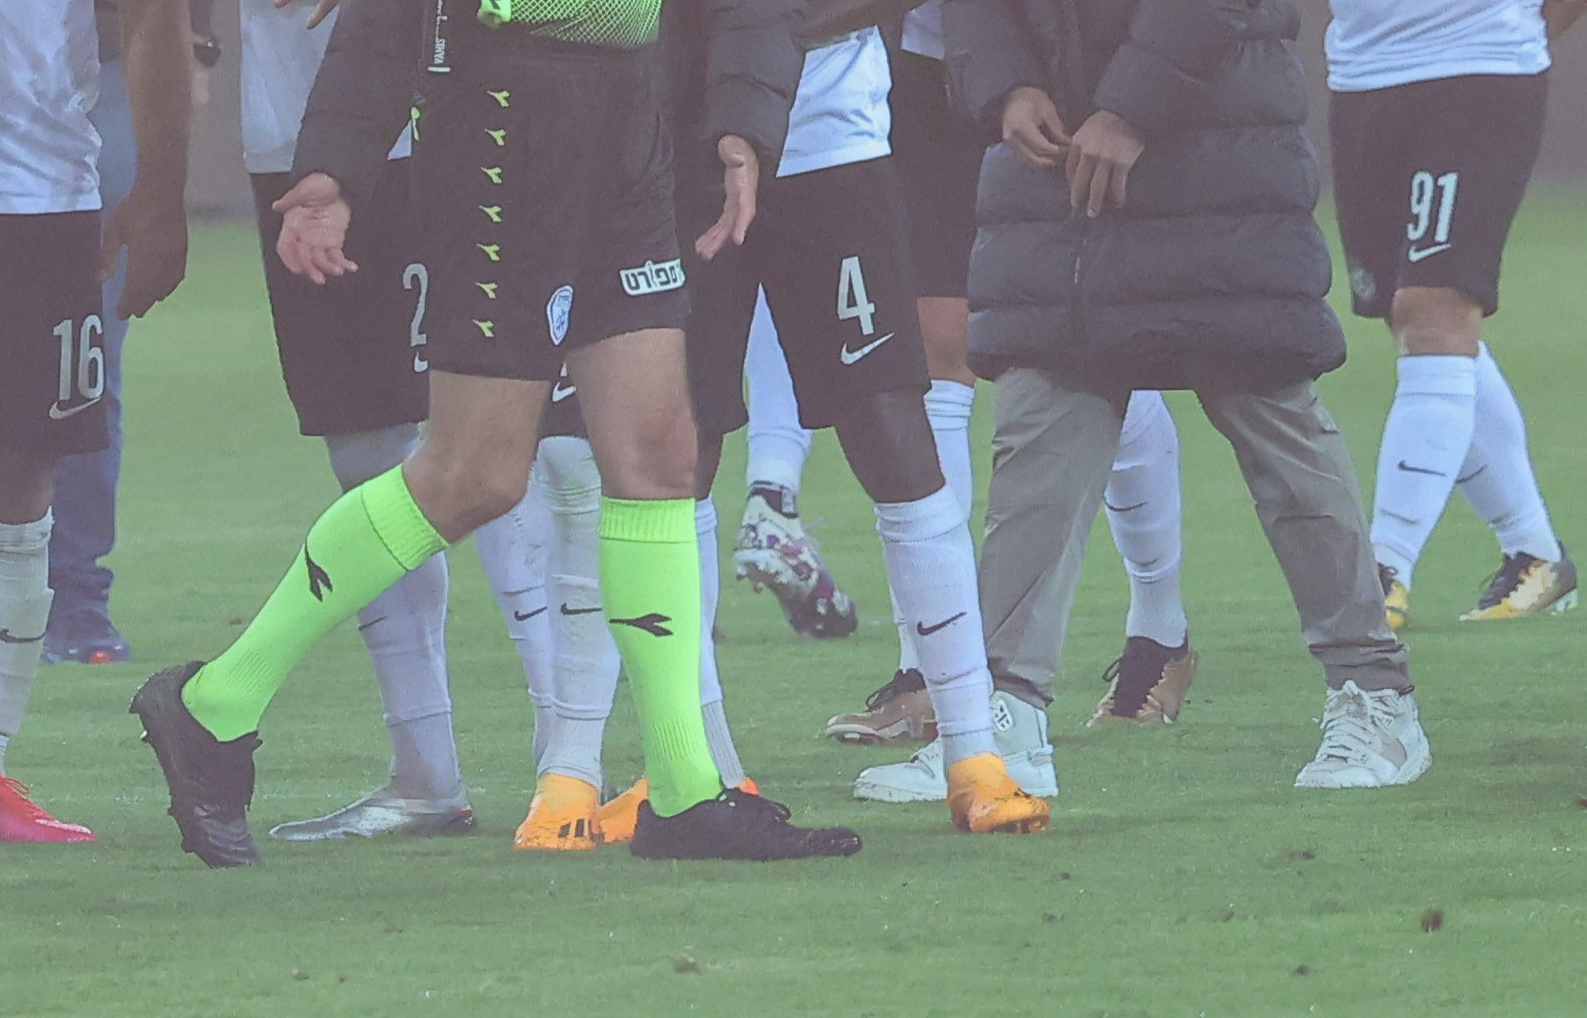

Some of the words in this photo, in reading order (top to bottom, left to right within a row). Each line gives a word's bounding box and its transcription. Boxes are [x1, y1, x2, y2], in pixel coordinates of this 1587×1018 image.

[1407, 170, 1458, 242] 91
[838, 256, 875, 336] 4
[53, 315, 105, 400] 16
